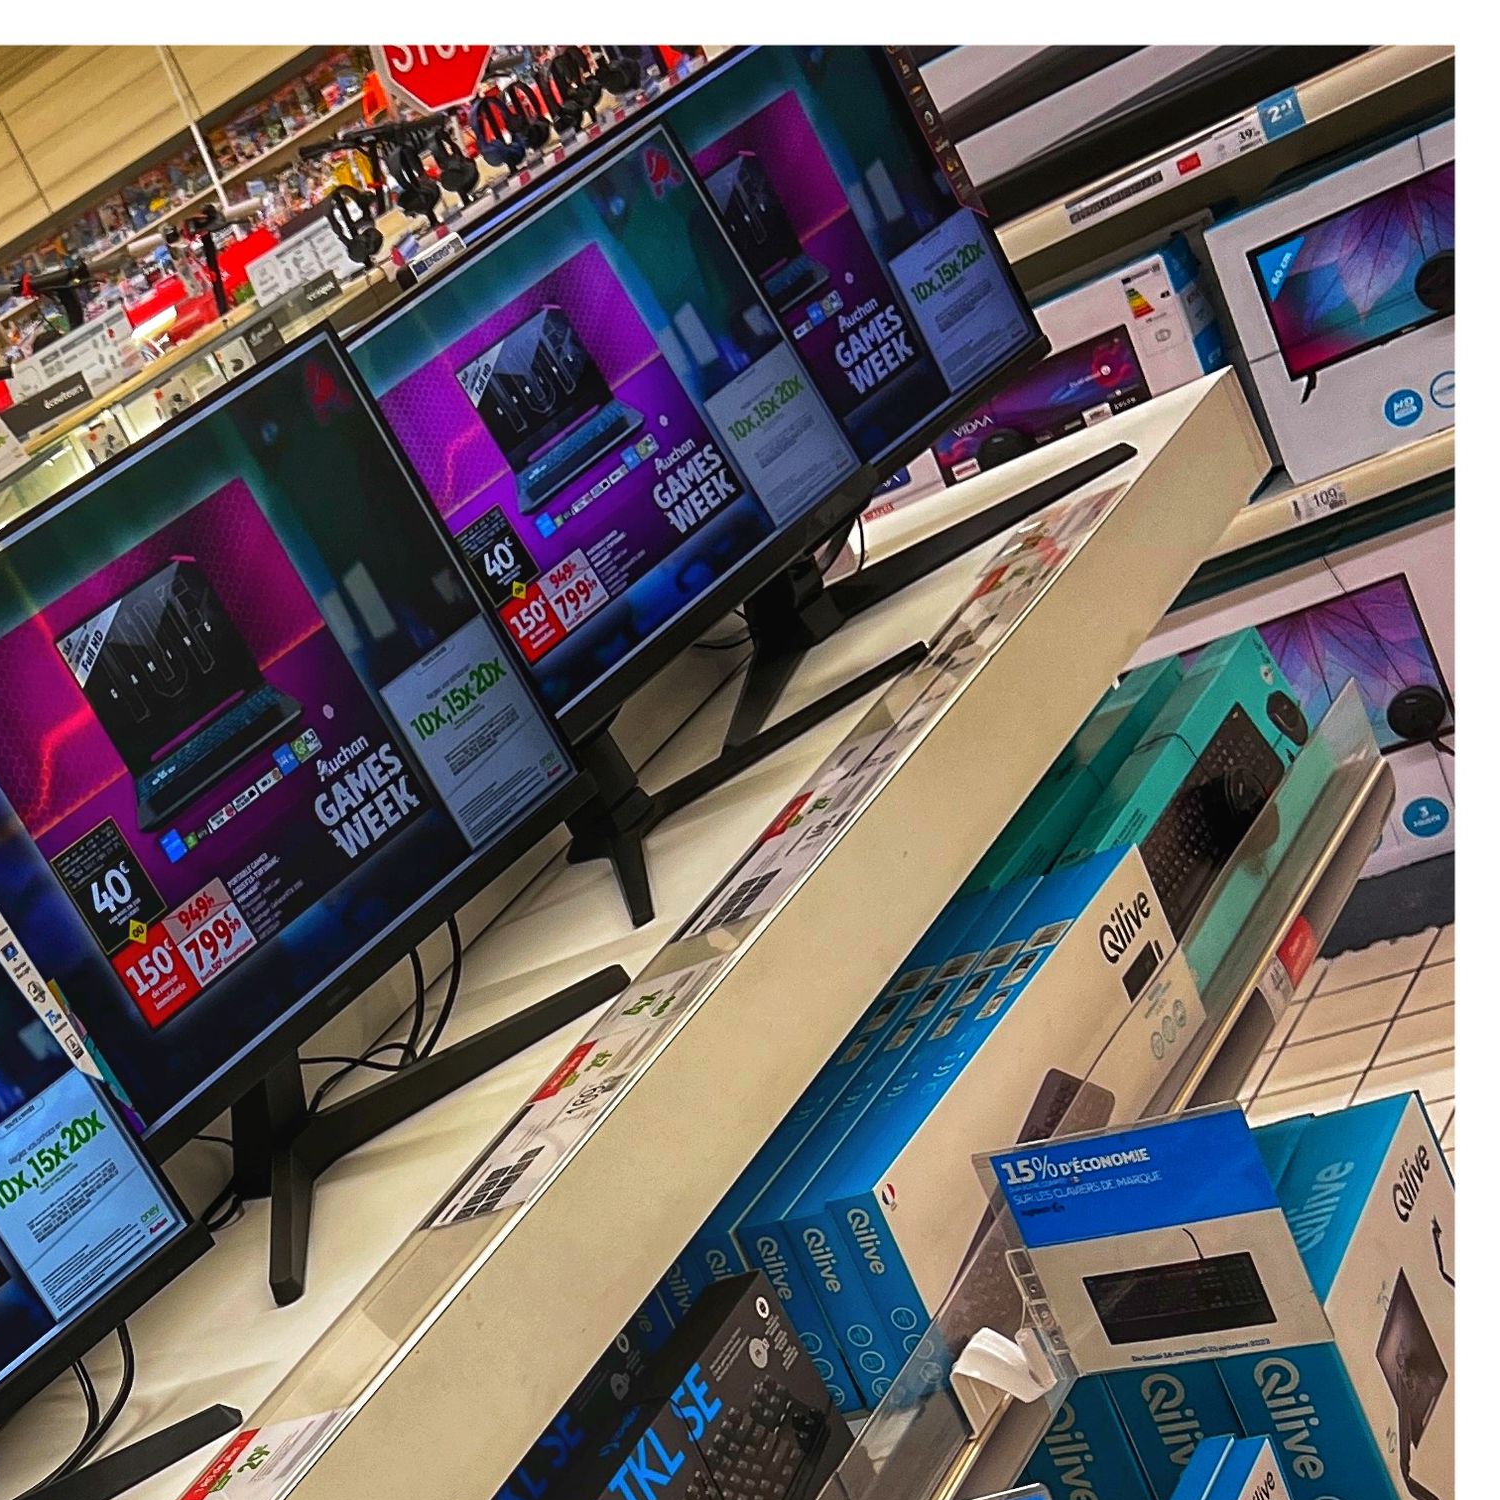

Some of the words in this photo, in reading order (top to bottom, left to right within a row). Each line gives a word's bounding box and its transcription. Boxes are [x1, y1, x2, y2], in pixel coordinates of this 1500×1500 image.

[834, 303, 902, 367] GAMES
[836, 297, 880, 333] Auchan
[846, 333, 916, 396] WEEK
[652, 442, 723, 507] GAMES
[654, 435, 695, 473] Auchan
[664, 471, 738, 535] WEEK
[313, 742, 403, 828] GAMES
[315, 734, 369, 781] Auchan
[334, 775, 422, 860] WEEK
[1099, 890, 1151, 965] Qilive
[1001, 1155, 1059, 1186] 15%
[1061, 1148, 1150, 1176] D'ÉCONOMIE
[1117, 1170, 1163, 1187] MARQUE
[1393, 1144, 1431, 1223] Qilive
[756, 1236, 793, 1300] Qilive
[802, 1225, 842, 1296] Qilive
[845, 1206, 887, 1277] Qilive
[669, 1362, 724, 1443] SE
[1140, 1372, 1204, 1466] Qiliv
[1252, 1356, 1325, 1481] Qilive
